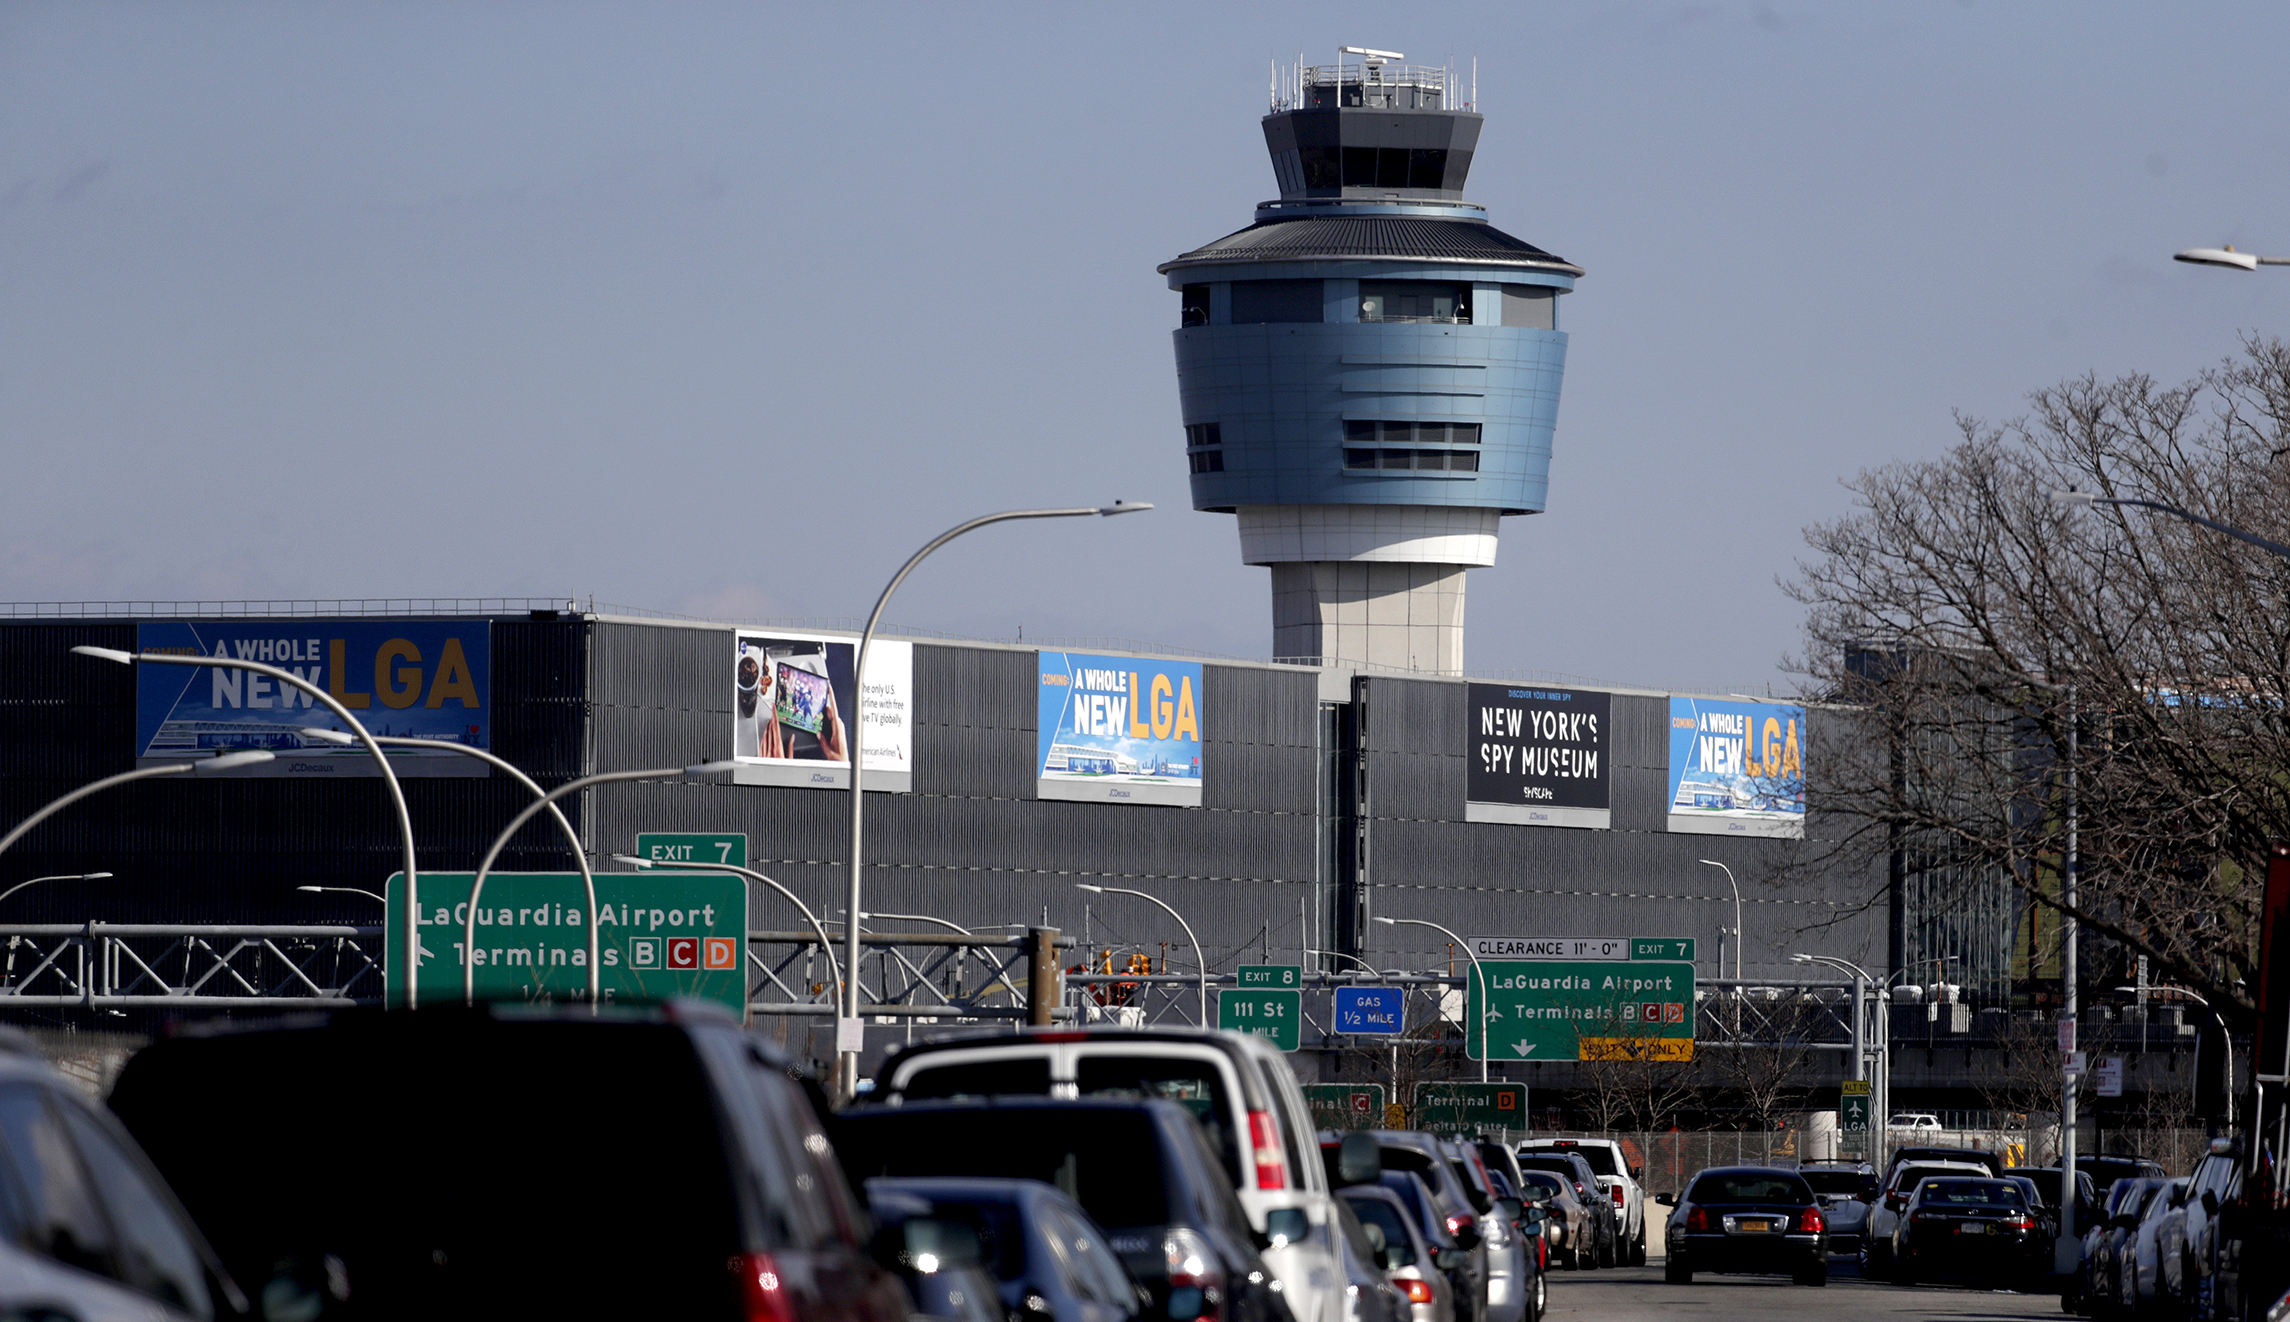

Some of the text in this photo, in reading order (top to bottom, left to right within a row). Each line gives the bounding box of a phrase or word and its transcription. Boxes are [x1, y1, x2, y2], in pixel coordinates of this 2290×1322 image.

[214, 639, 321, 661] A WHOLE
[329, 638, 480, 709] LGA
[1042, 673, 1070, 686] COMING:
[1075, 668, 1127, 692] A WHOLE
[212, 665, 322, 709] NEW
[871, 684, 883, 697] only
[885, 685, 895, 695] U.S.
[1508, 690, 1571, 701] DISCOVER YOUR INNER SPY
[879, 698, 892, 709] with
[893, 699, 904, 710] free
[1129, 672, 1199, 742] LGA
[871, 713, 879, 723] TV
[880, 713, 903, 727] globally.
[1074, 694, 1127, 737] NEW
[1481, 707, 1597, 743] NEW YORK'S
[1700, 712, 1743, 734] A WHOLE
[880, 747, 896, 757] Airlines
[1700, 735, 1743, 774] NEW
[1745, 716, 1802, 779] LGA
[289, 763, 334, 772] JCDecaux
[1481, 743, 1597, 779] SPY MUSEUM
[651, 842, 732, 864] EXIT 7
[597, 903, 714, 931] Airport
[453, 941, 729, 966] Terminas B C D
[1478, 941, 1563, 955] CLEARANCE
[1639, 943, 1687, 956] EXIT 7
[1245, 970, 1293, 984] EXIT 8
[1493, 974, 1672, 993] LaGuardia Airport
[1357, 997, 1381, 1007] GAS
[1234, 1002, 1284, 1017] 111 St
[1515, 1004, 1680, 1020] Terminals B C D
[1344, 1011, 1395, 1025] 1/2 MILE
[1252, 1027, 1279, 1038] MILE
[1648, 1043, 1685, 1055] ONLY
[1844, 1083, 1868, 1091] ALT TO
[1355, 1097, 1366, 1110] C
[1426, 1094, 1511, 1107] Terminal D
[1844, 1121, 1867, 1131] LGA
